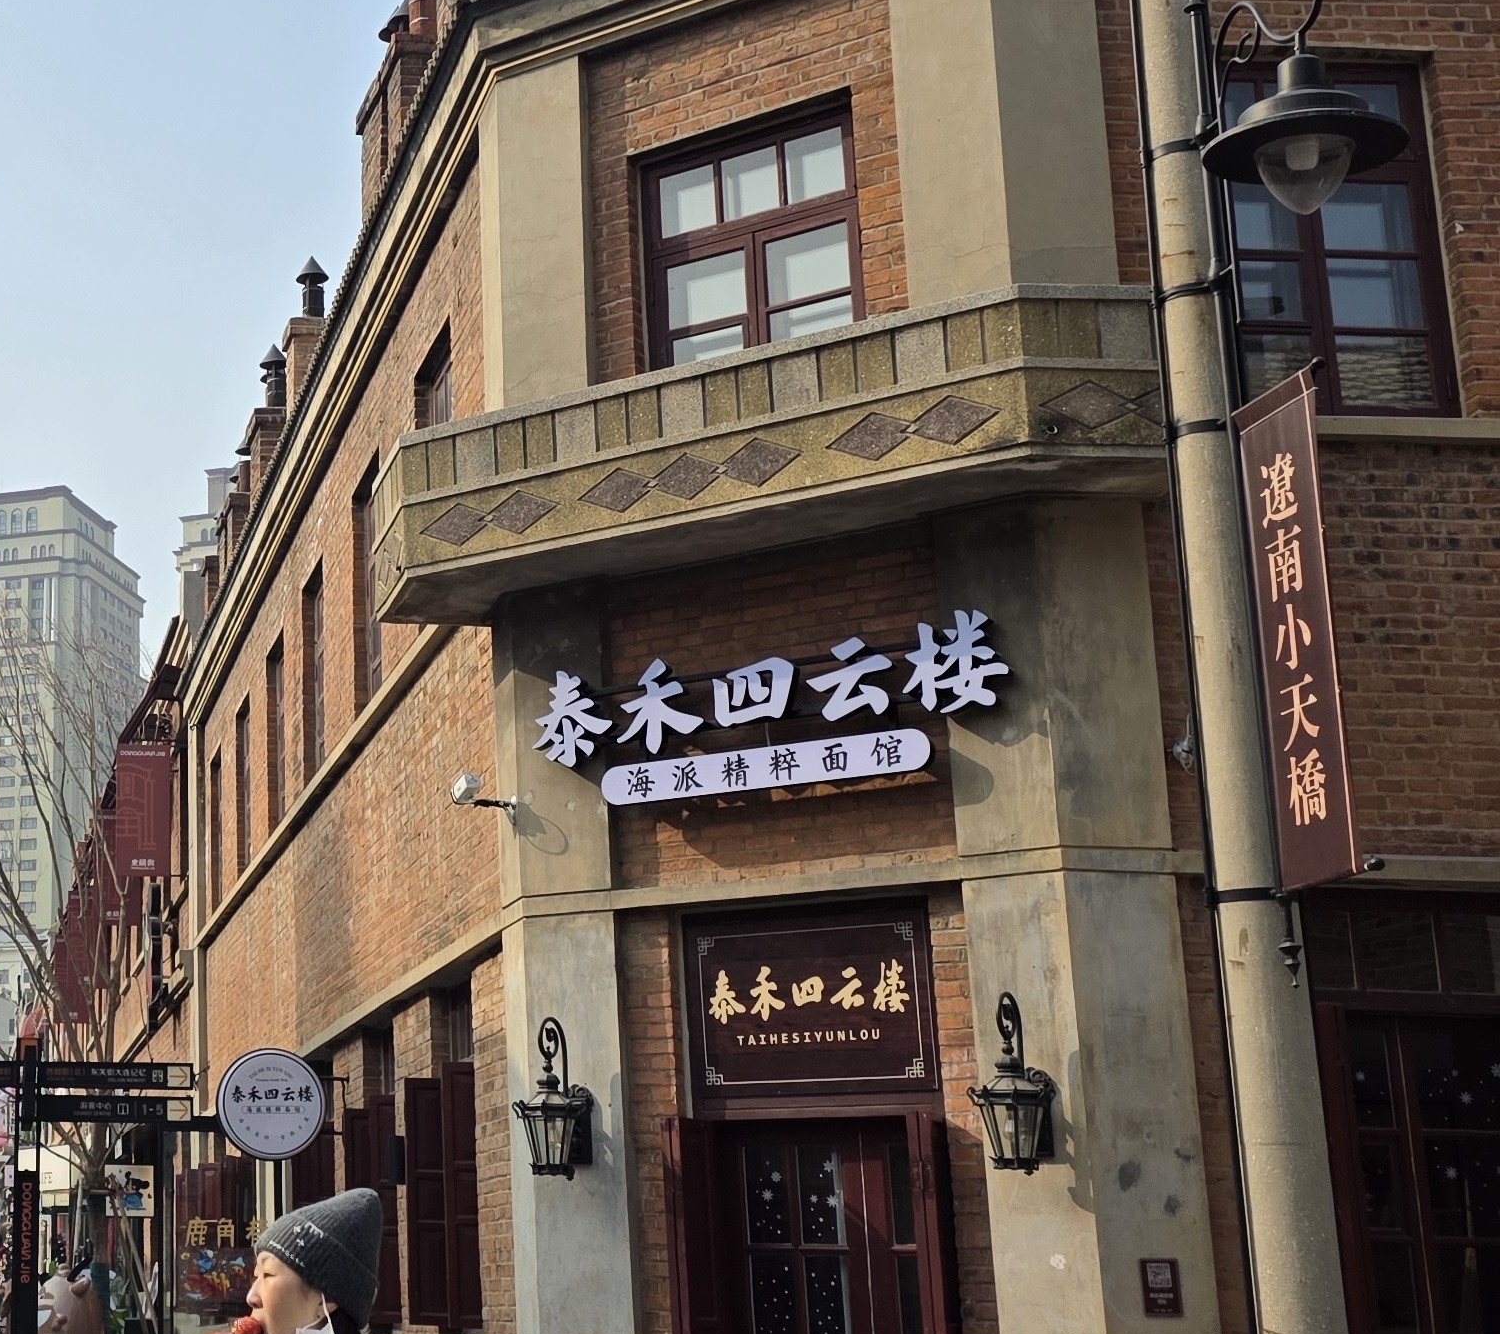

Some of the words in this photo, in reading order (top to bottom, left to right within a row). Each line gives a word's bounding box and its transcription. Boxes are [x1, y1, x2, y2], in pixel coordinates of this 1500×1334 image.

[532, 609, 1009, 768] 泰禾四云楼
[626, 734, 904, 799] 海派精粹面馆
[708, 958, 910, 1024] 泰禾四云楼
[736, 1028, 881, 1046] TAIHESIYUNLOU
[231, 1084, 315, 1104] 泰禾四云楼
